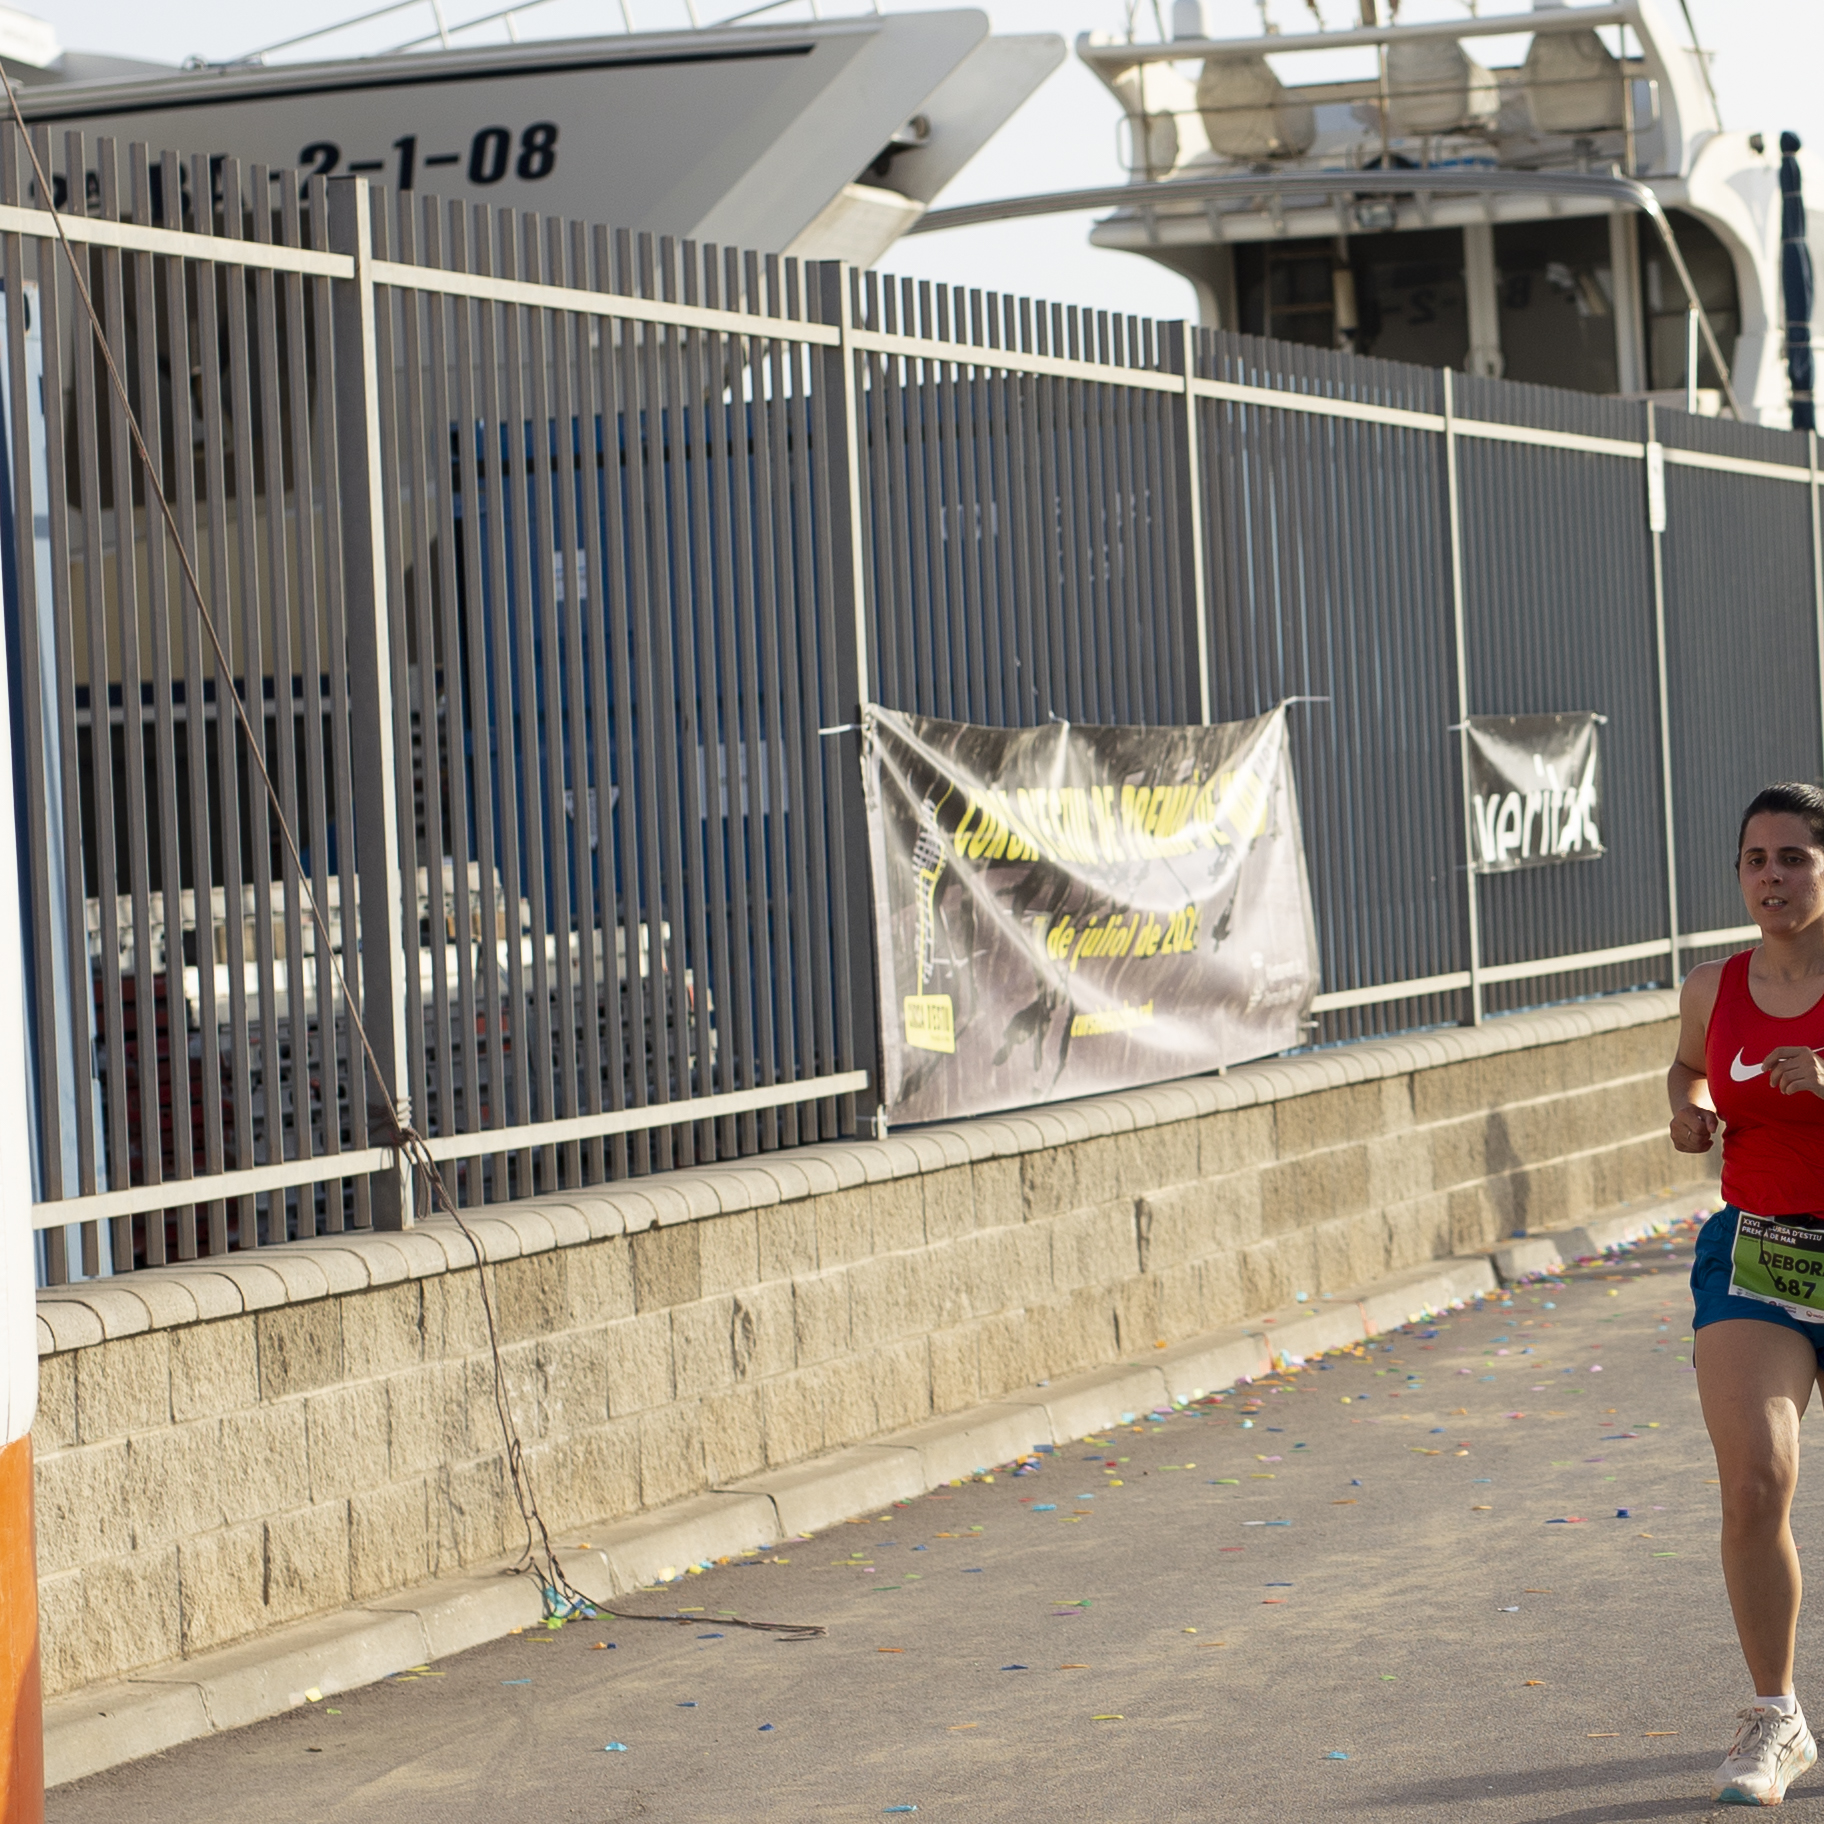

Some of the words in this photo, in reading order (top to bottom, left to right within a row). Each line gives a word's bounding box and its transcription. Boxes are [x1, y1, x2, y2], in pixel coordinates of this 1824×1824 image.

[1046, 914, 1076, 961] de
[1069, 912, 1141, 973] juliol
[1133, 911, 1162, 957] de
[1769, 1232, 1779, 1241] DE
[1780, 1235, 1797, 1245] MAR
[1791, 1229, 1823, 1242] D'ESTIU
[1774, 1276, 1816, 1299] 687
